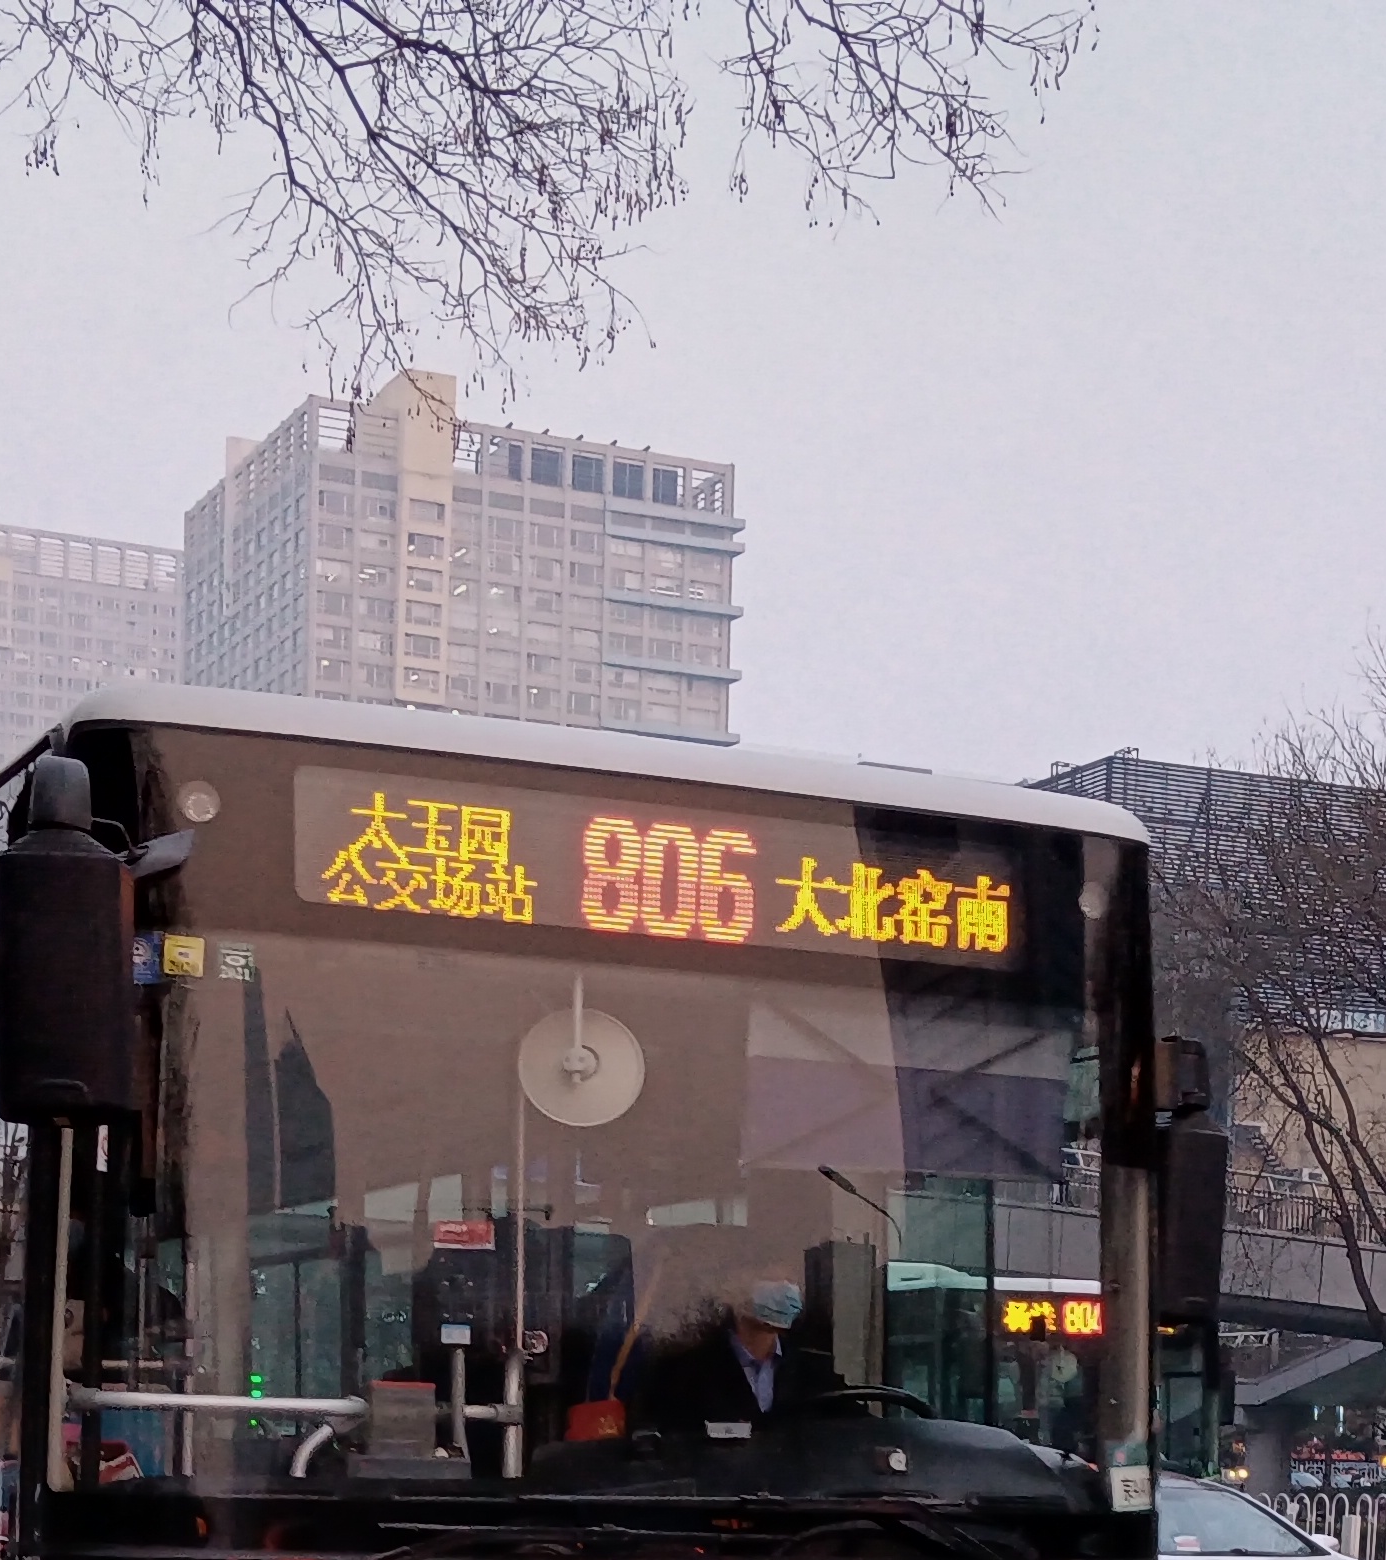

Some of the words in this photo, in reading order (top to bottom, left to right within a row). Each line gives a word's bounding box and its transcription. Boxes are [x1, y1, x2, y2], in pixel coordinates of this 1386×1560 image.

[321, 850, 539, 925] 公交场站
[581, 815, 756, 944] 806
[774, 856, 1011, 953] 大北窑南
